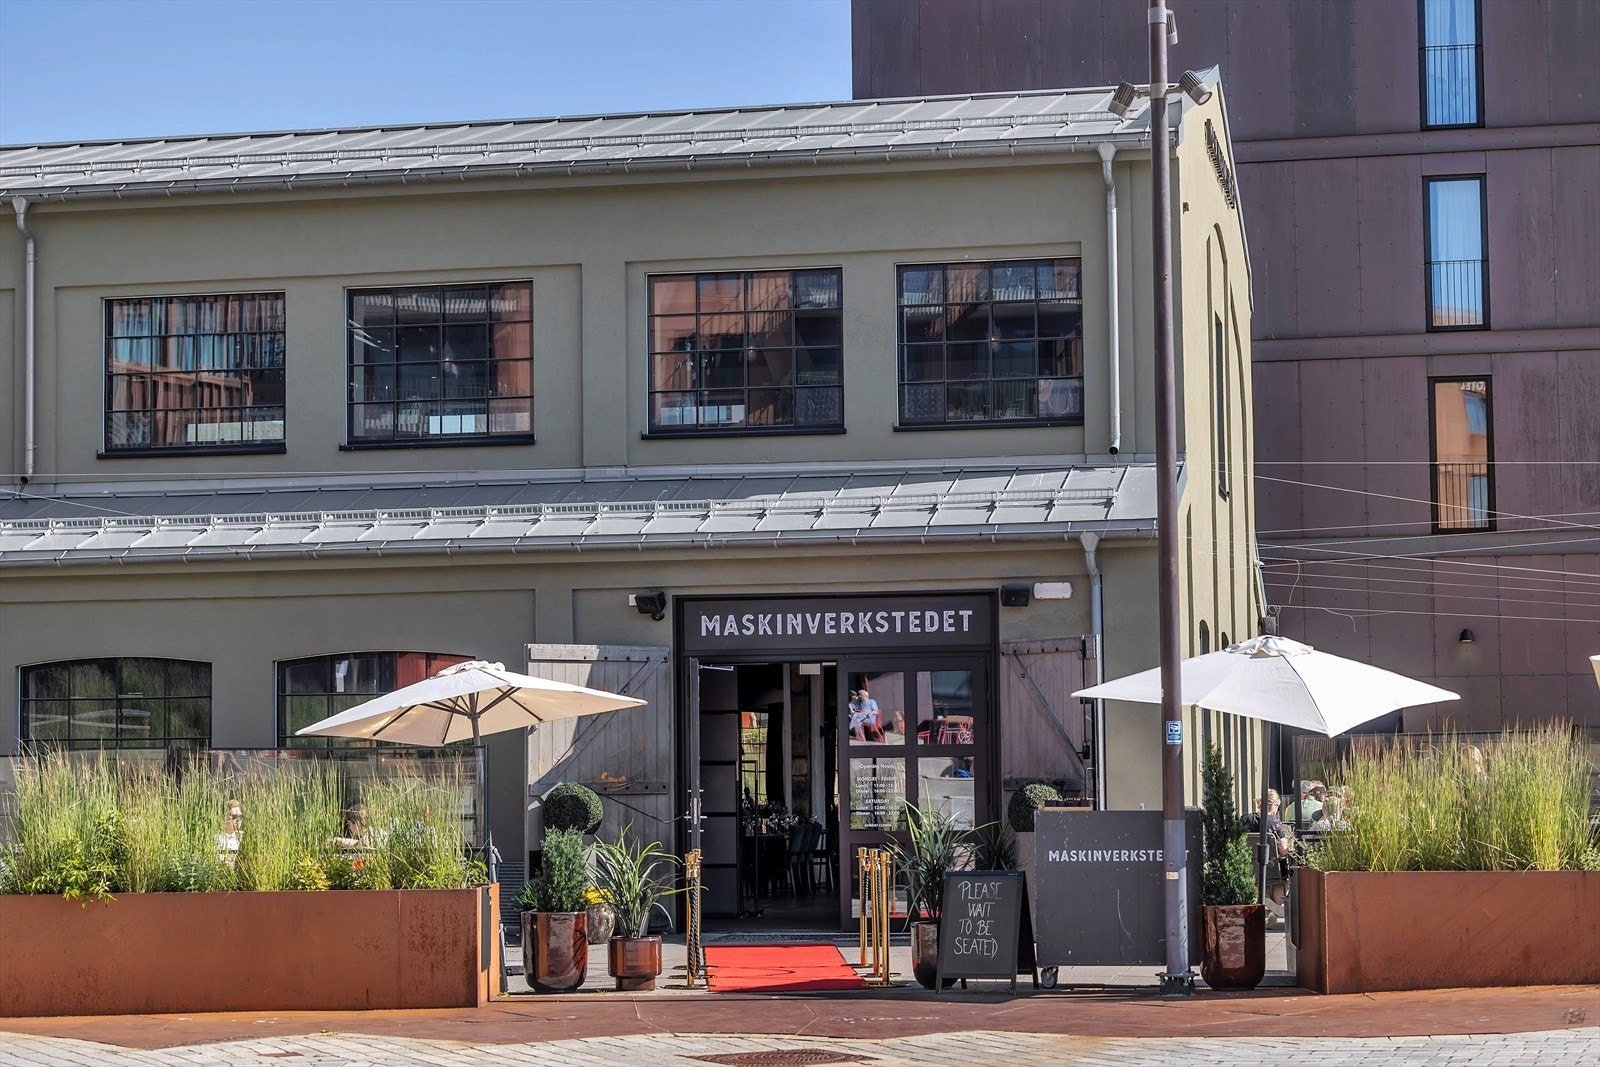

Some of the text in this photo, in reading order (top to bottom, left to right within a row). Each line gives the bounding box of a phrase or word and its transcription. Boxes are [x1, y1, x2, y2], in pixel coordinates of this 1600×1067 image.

[701, 610, 973, 636] MASKINVERKSTEDET
[1048, 849, 1190, 862] MASKINVERKSTET
[958, 880, 1003, 901] PLEASE
[968, 902, 995, 918] WAIT
[959, 918, 995, 936] TO BE
[953, 937, 998, 958] SEATED
